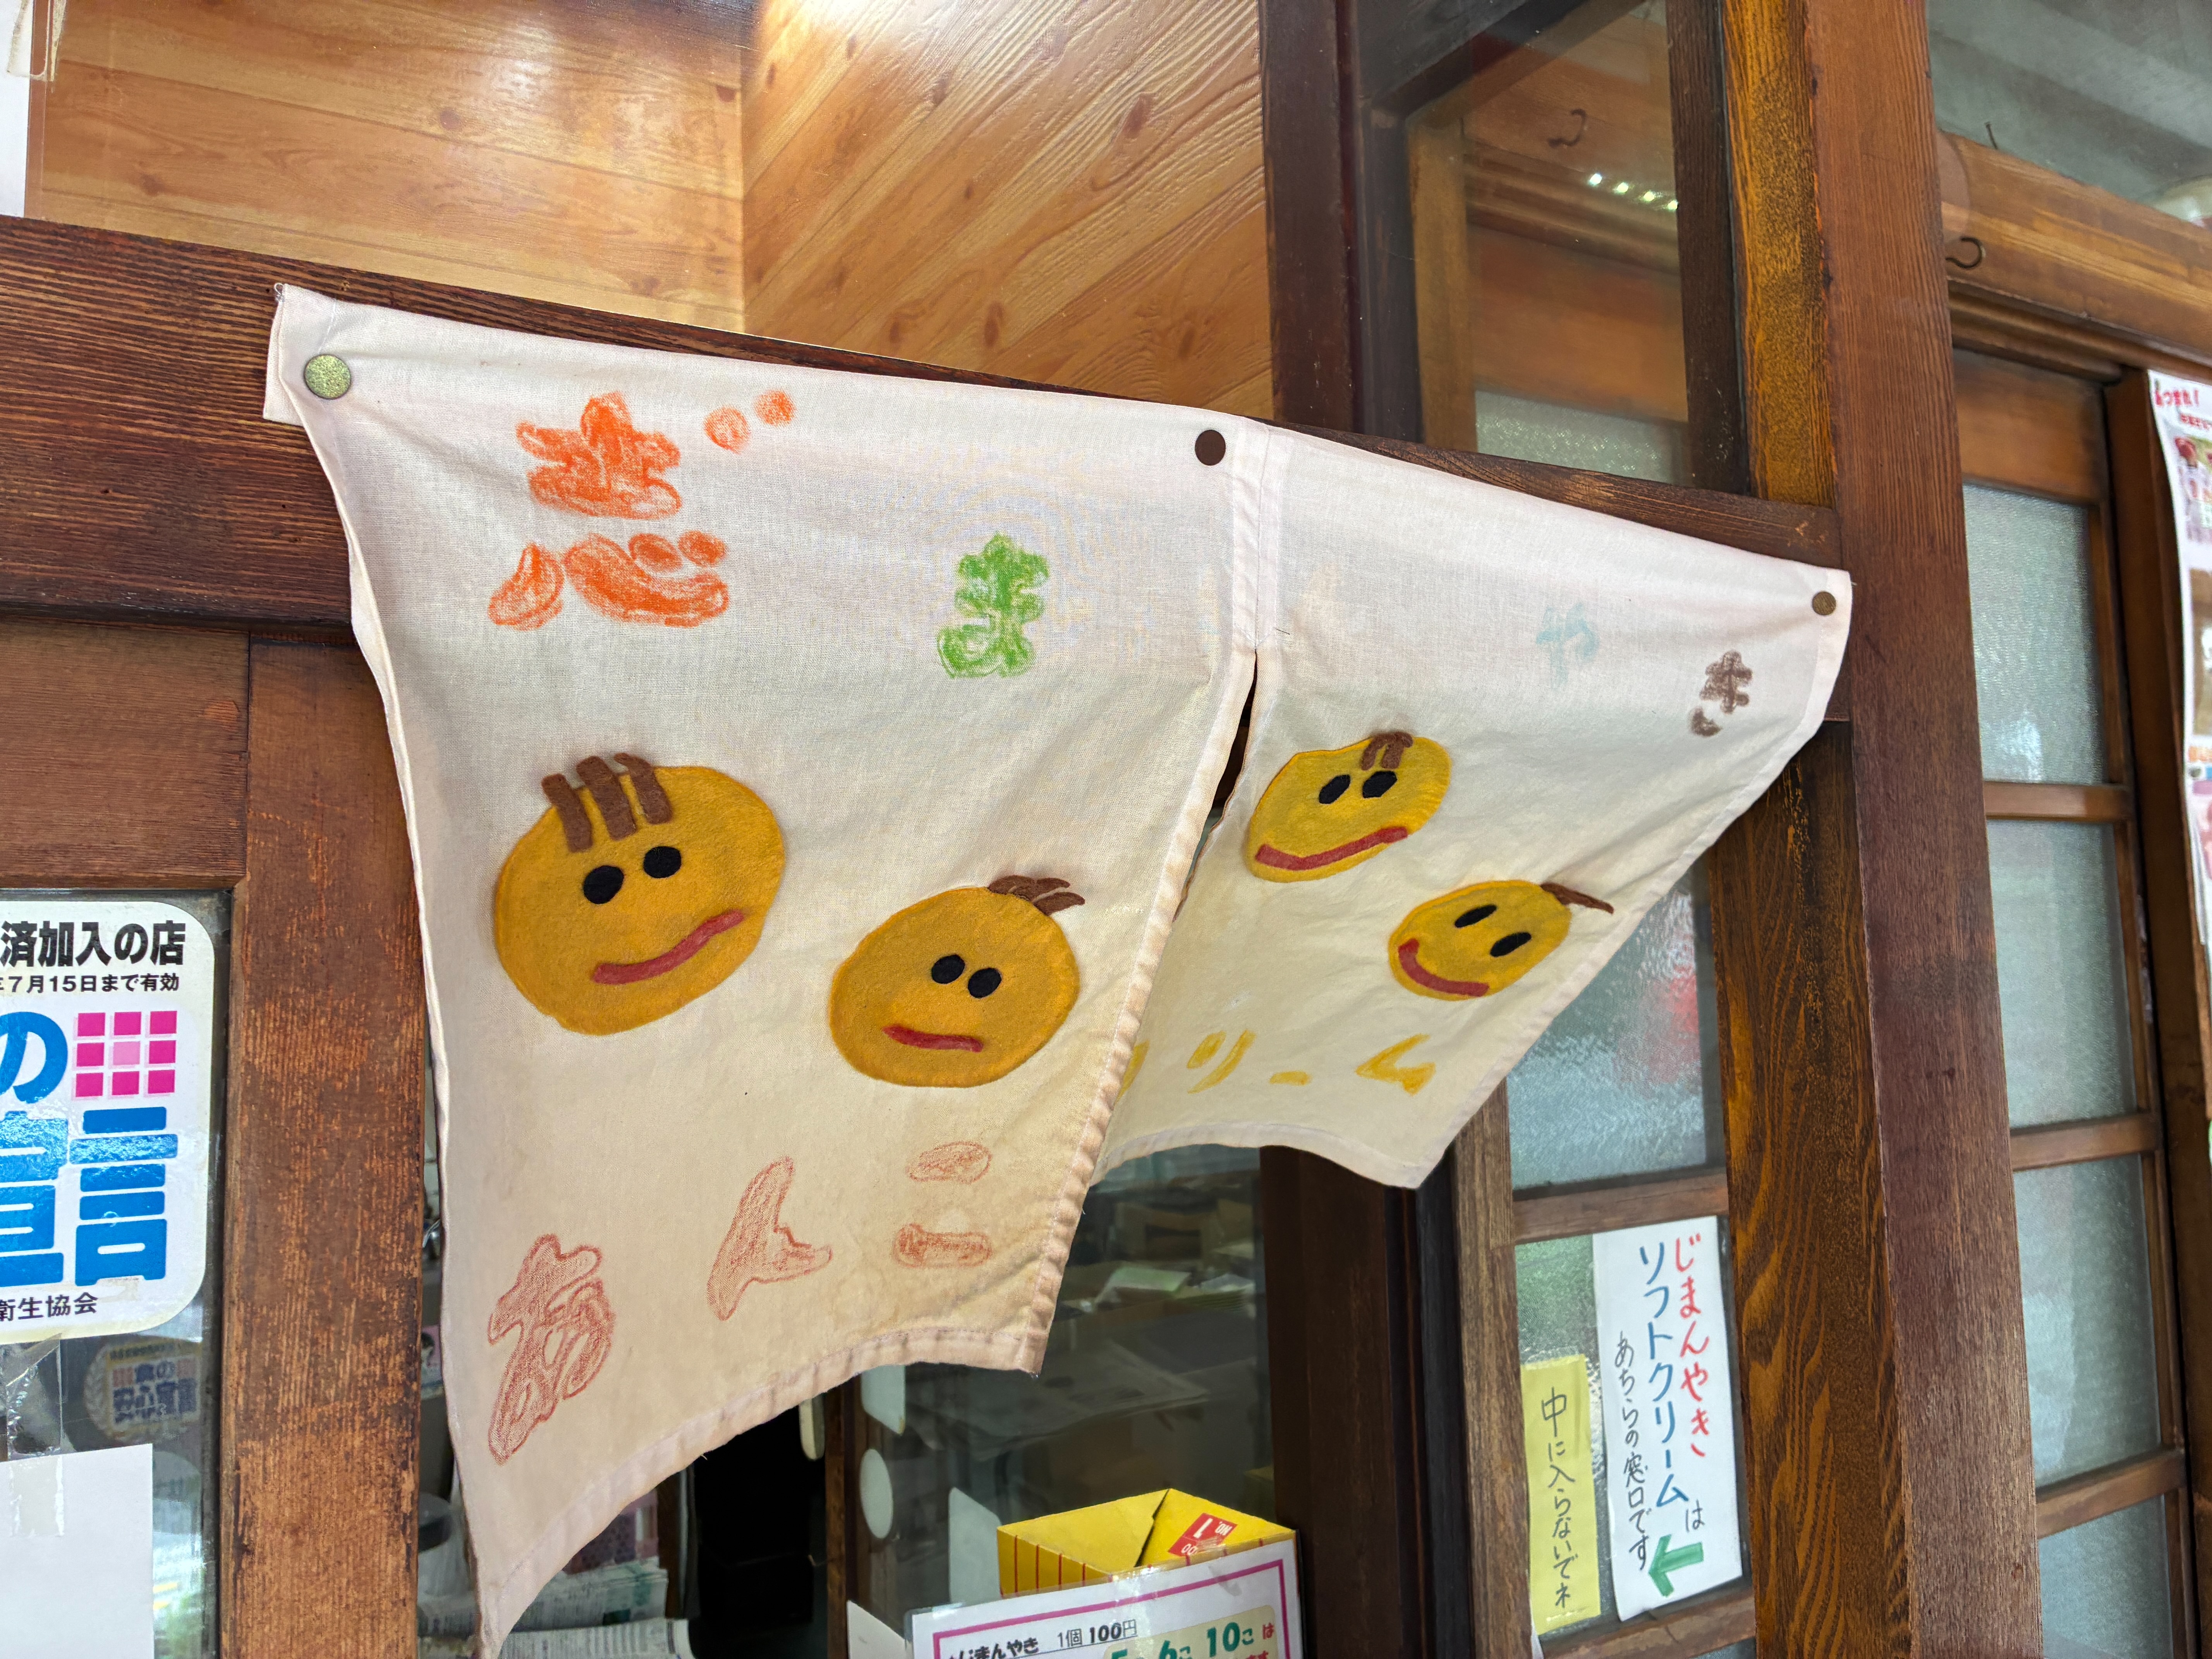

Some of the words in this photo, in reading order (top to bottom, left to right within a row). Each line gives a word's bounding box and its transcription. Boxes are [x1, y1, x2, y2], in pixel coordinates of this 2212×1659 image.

[0, 972, 179, 993] 7月15日まで有効
[1614, 1331, 1651, 1571] あちらの窓口です
